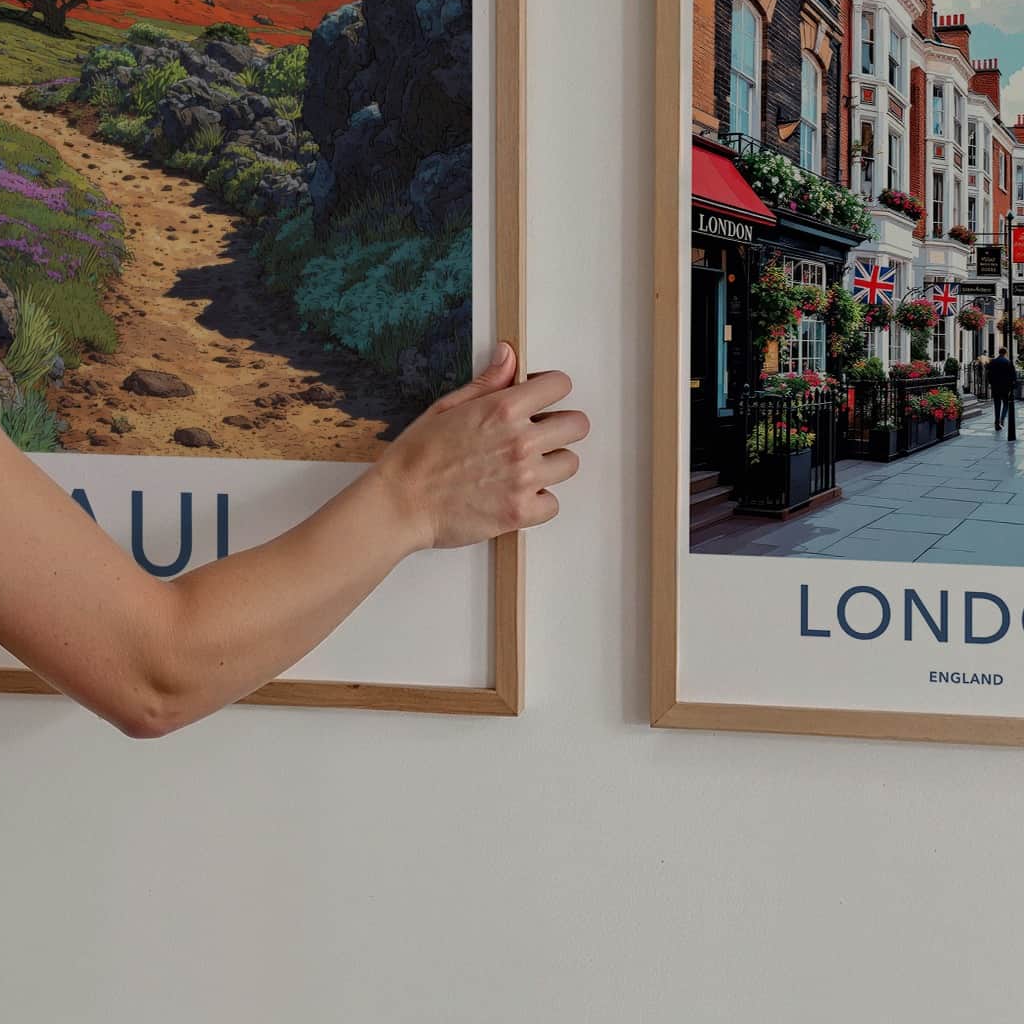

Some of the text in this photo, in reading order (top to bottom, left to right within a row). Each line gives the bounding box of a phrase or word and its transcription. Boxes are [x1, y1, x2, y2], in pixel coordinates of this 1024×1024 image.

[698, 213, 753, 242] LONDON
[72, 488, 229, 578] UI
[800, 584, 1024, 645] LOND
[929, 671, 1004, 686] ENGLAND
